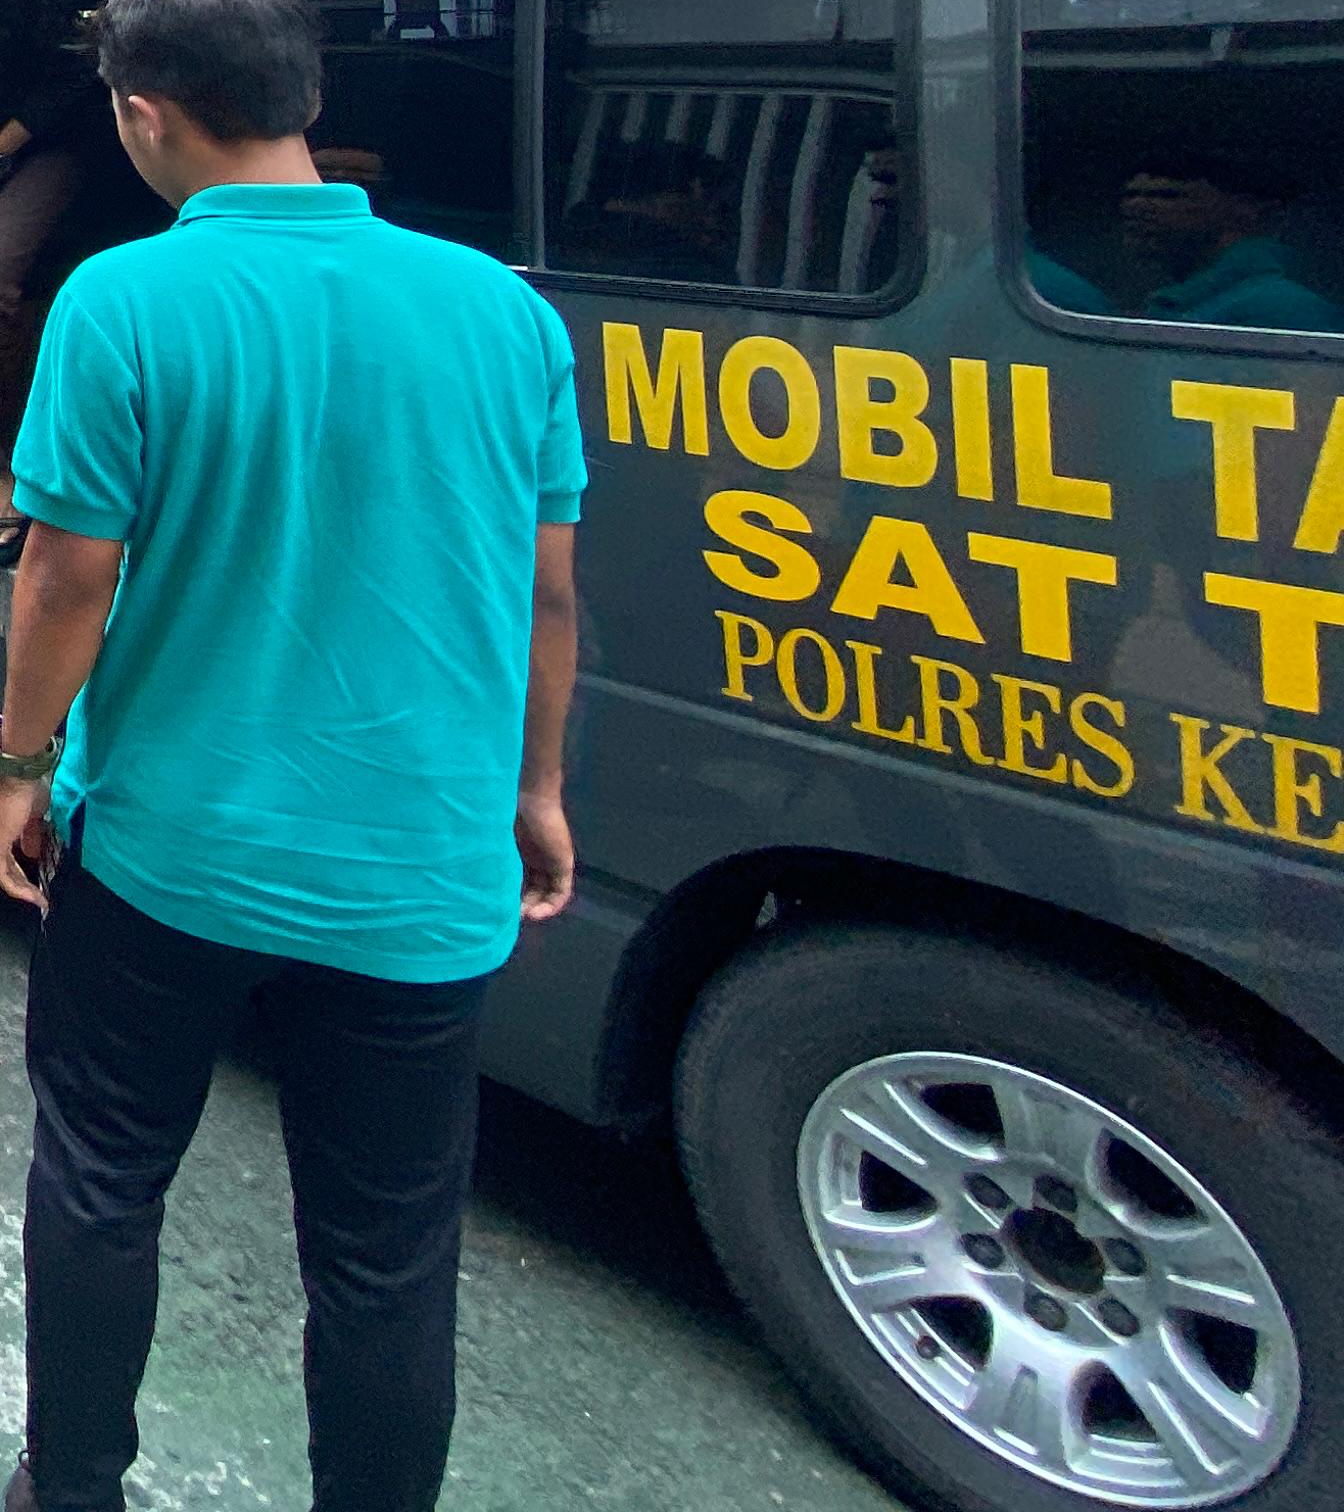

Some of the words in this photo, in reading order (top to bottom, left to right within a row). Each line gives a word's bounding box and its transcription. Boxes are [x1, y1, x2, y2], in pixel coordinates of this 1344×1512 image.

[602, 322, 1113, 522] MOBIL
[702, 488, 1118, 664] SAT
[715, 609, 1136, 798] POLRES
[1169, 712, 1344, 855] KE
